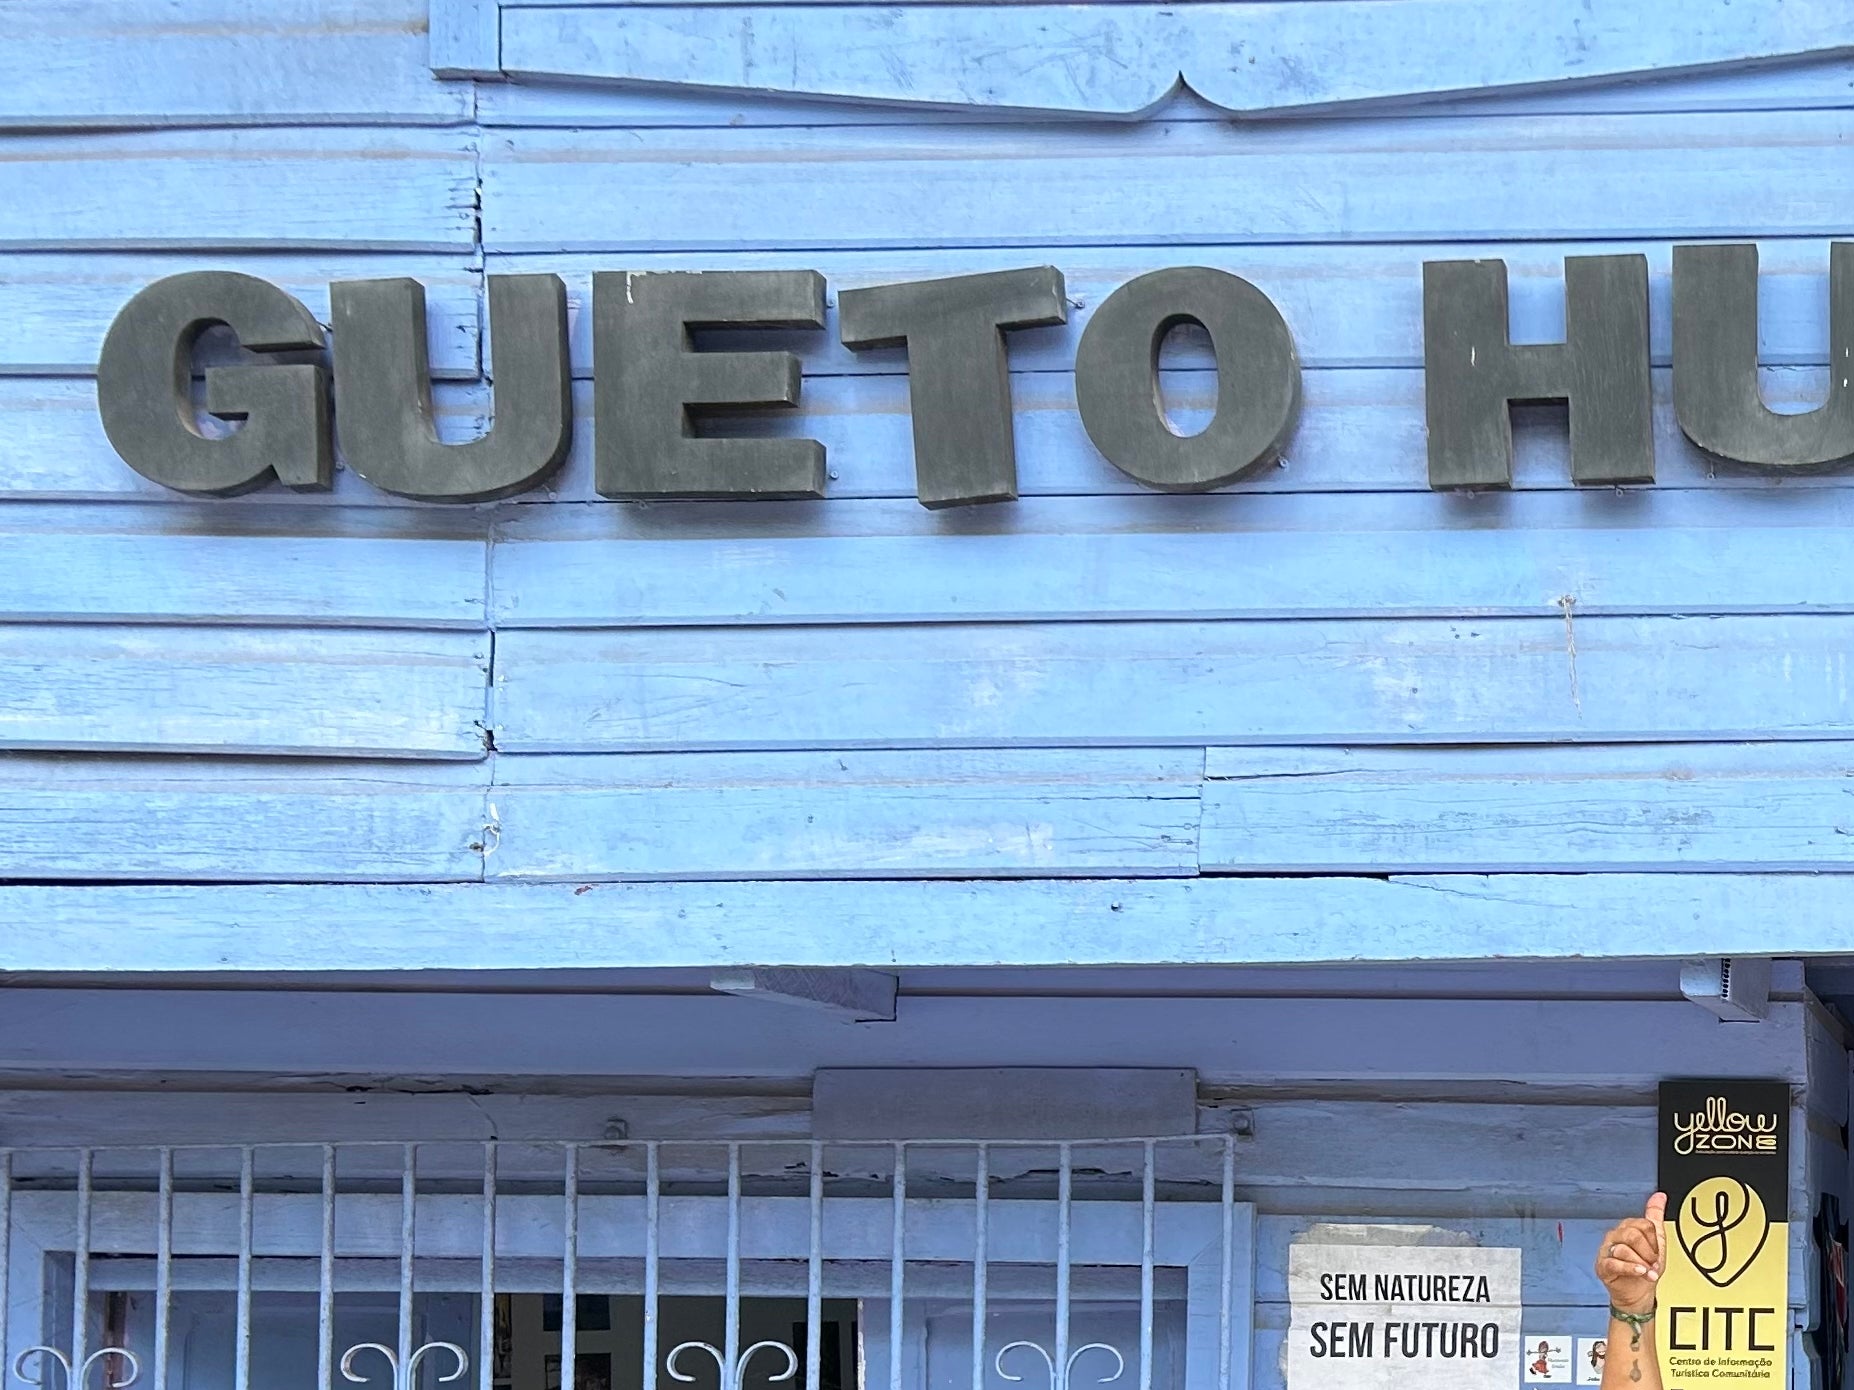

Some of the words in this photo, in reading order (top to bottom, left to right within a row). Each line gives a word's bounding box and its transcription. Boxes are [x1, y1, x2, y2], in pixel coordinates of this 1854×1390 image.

[97, 264, 1298, 511] GUETO
[1673, 1096, 1778, 1155] yellow
[1695, 1133, 1777, 1150] ZONE
[1319, 1273, 1367, 1301] SEM
[1374, 1274, 1491, 1303] NATUREZA
[1309, 1321, 1375, 1358] SEM
[1383, 1322, 1500, 1359] FUTURO
[1668, 1306, 1775, 1352] CITC
[1669, 1356, 1702, 1366] Centro
[1703, 1356, 1717, 1366] de
[1718, 1356, 1773, 1369] Informação
[1670, 1368, 1710, 1378] Turística
[1711, 1368, 1771, 1379] Comunitária
